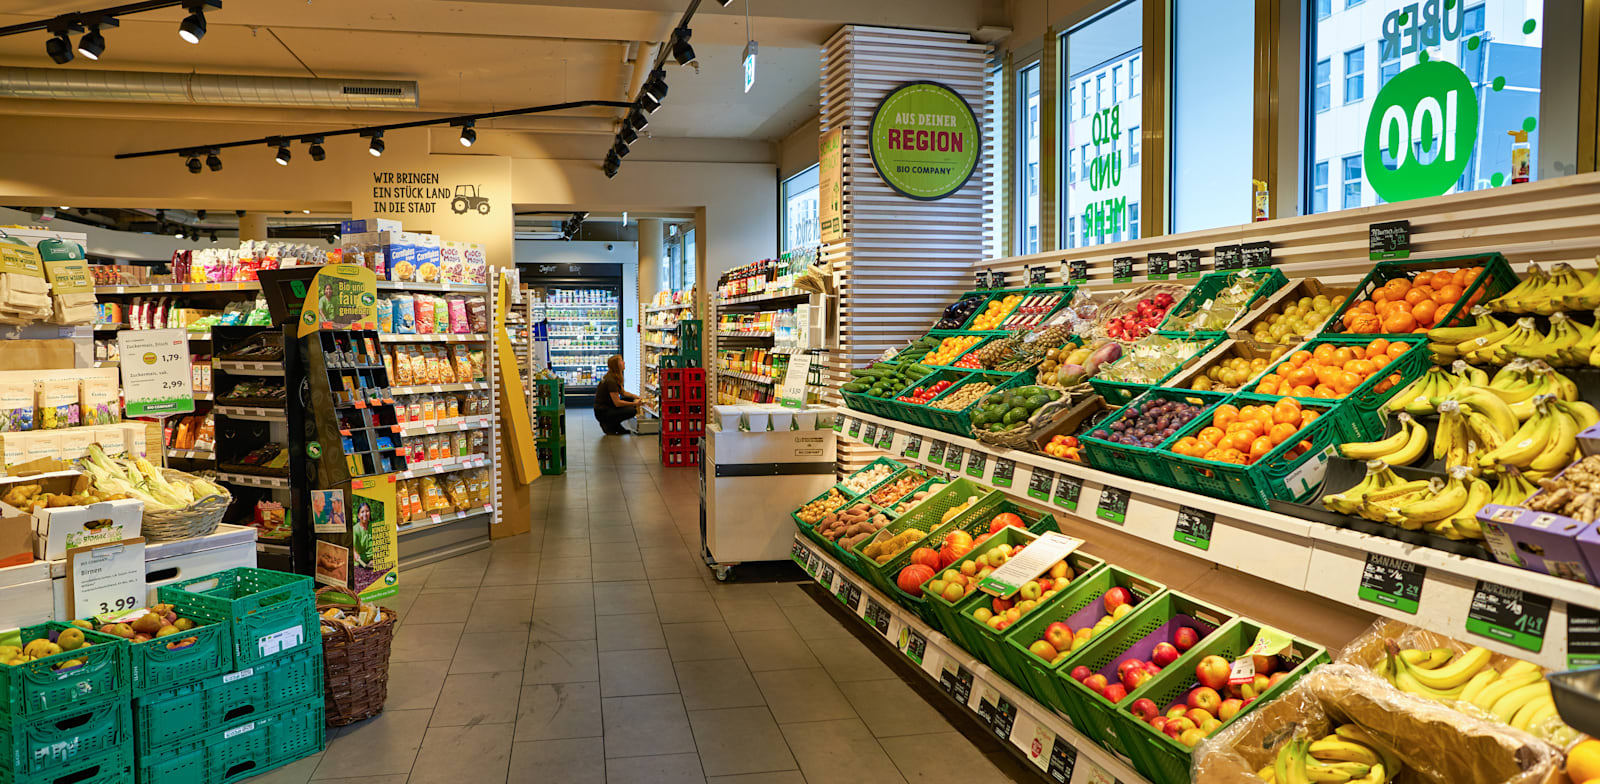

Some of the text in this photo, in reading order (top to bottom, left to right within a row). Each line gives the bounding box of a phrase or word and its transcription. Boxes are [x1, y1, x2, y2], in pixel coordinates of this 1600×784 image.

[895, 112, 957, 127] AUS DEINER
[888, 128, 963, 153] REGION
[912, 166, 951, 175] COMPANY
[373, 172, 439, 184] WIR BRINGEN
[373, 185, 451, 199] EIN STÜCK LAND
[374, 201, 436, 213] IN DIE STADT
[338, 281, 365, 291] Bio und
[339, 291, 358, 305] fair
[162, 380, 183, 389] 2,99
[1371, 553, 1416, 572] BANANEN
[81, 567, 102, 576] Birnen
[1393, 582, 1404, 596] 2
